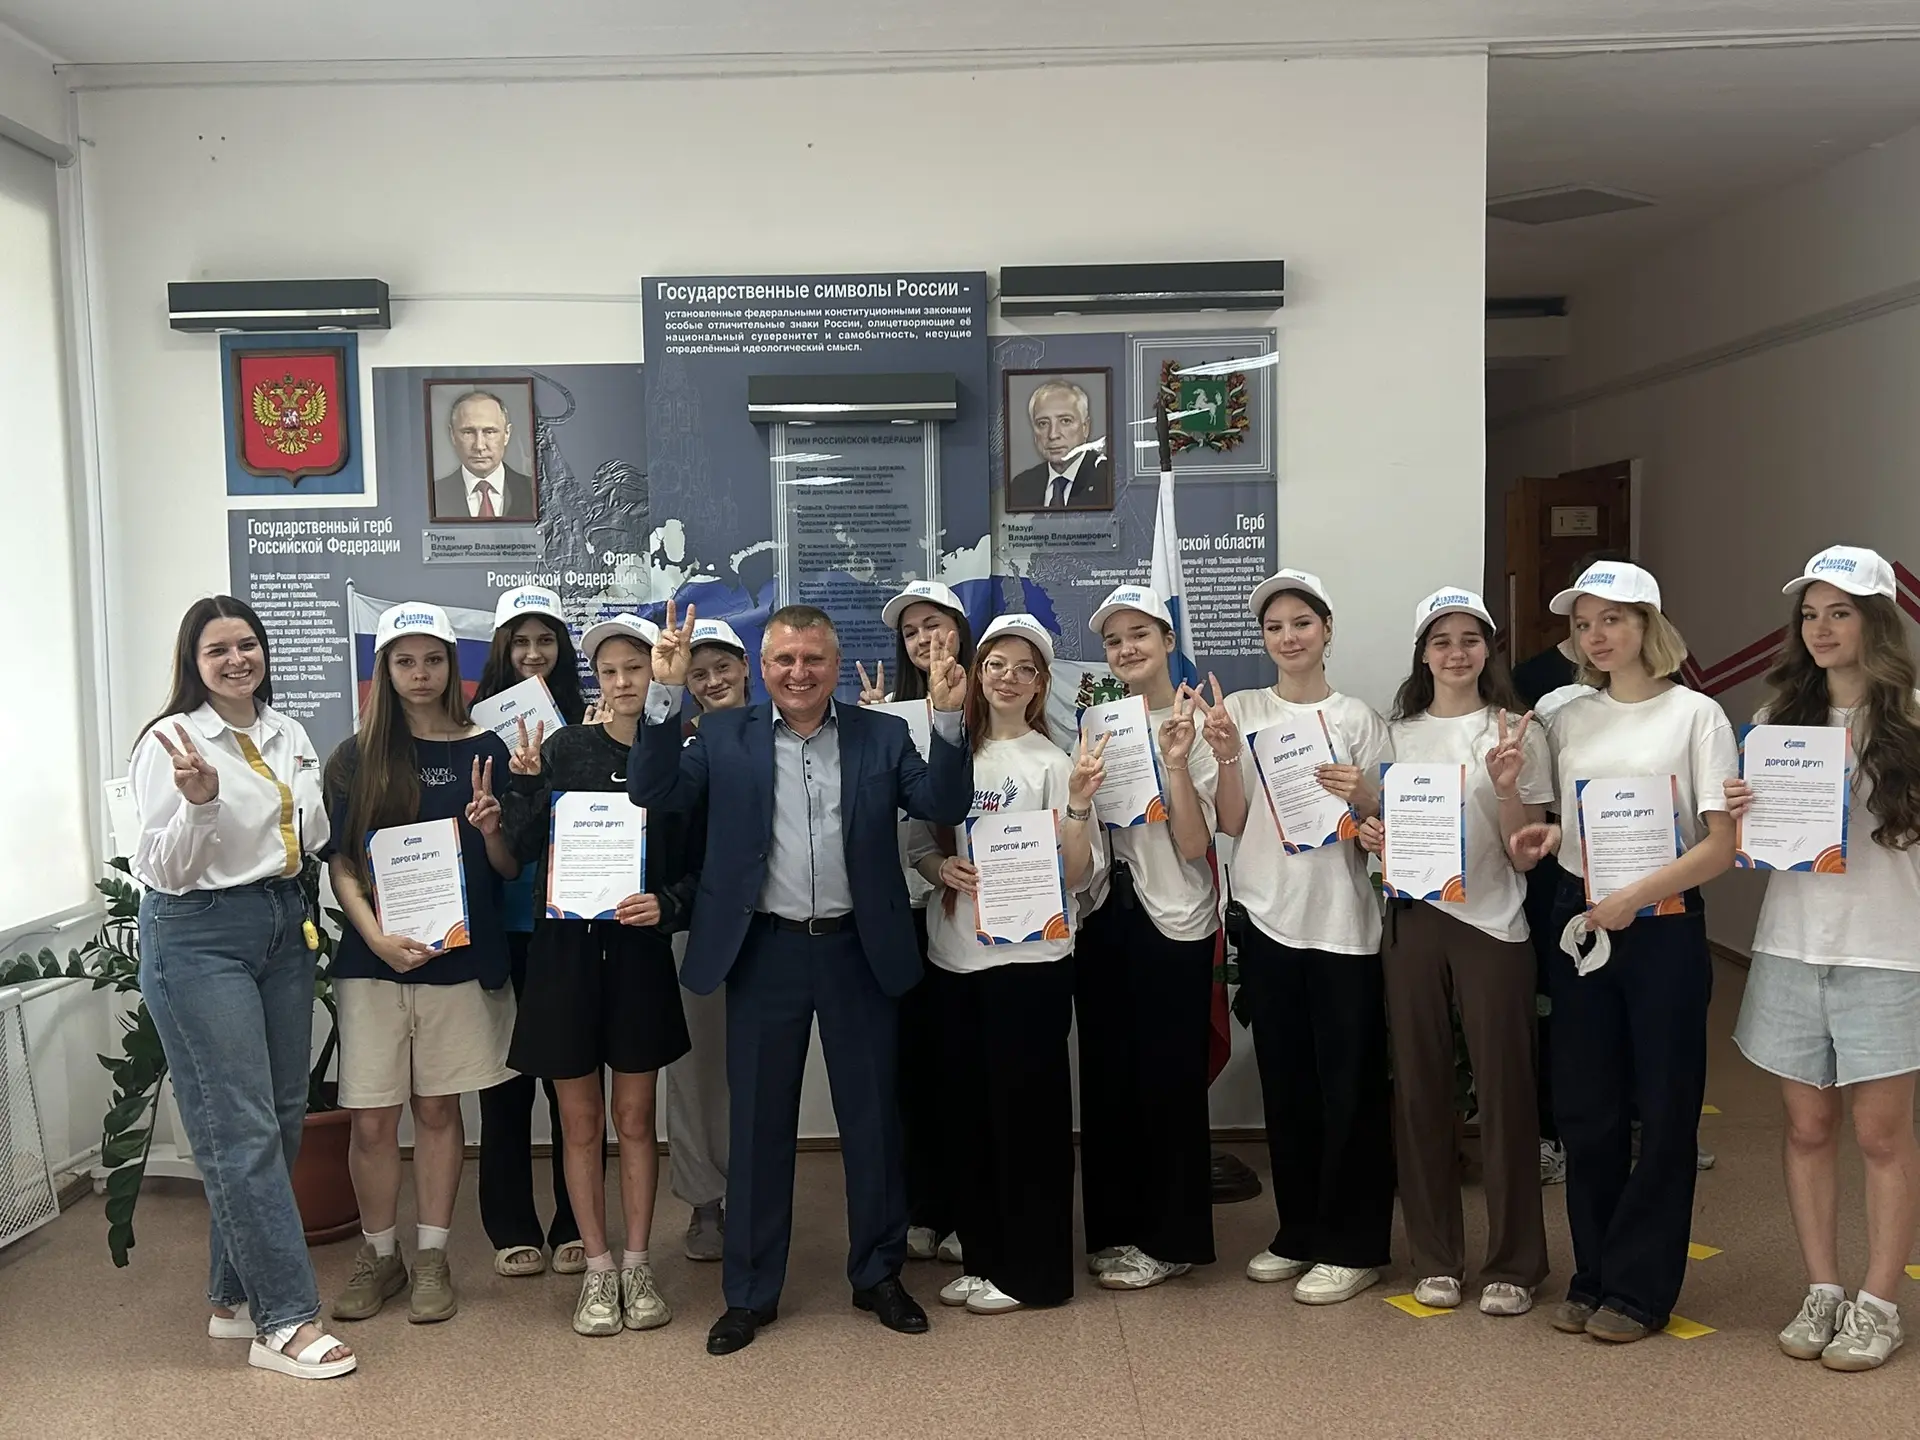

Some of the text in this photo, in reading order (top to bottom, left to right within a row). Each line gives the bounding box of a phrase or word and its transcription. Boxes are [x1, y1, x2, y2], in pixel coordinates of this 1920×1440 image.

[657, 282, 809, 303] Государственные
[814, 281, 892, 299] символы
[896, 279, 959, 298] России
[665, 306, 972, 320] установленные федеральными конституционными законами
[665, 316, 972, 331] особые отличительные знаки России, олицетворяющие её
[665, 329, 972, 343] национальный суверенитет и самобытность, несущие
[666, 342, 863, 355] определённый идеологический смысл.
[812, 436, 869, 445] РОССИЙСКОЙ
[871, 435, 922, 445] ФЕДЕРАЦИИ
[248, 516, 393, 538] Государственный герб
[1008, 525, 1033, 533] Мазур
[1236, 514, 1265, 532] Герб
[430, 534, 455, 542] Путин
[1008, 532, 1112, 541] Владимир Владимирович
[1214, 535, 1265, 550] области
[249, 536, 401, 556] Российской Федерации
[431, 543, 473, 551] Владимир
[602, 549, 637, 567] Флаг
[487, 570, 637, 587] Российской Федерации
[1764, 758, 1800, 767] ДОРОГОЙ
[1600, 809, 1632, 819] ДОРОГОЙ
[573, 820, 604, 828] ДОРОГОЙ
[990, 842, 1020, 853] ДОРОГОЙ
[390, 854, 421, 866] ДОРОГОЙ
